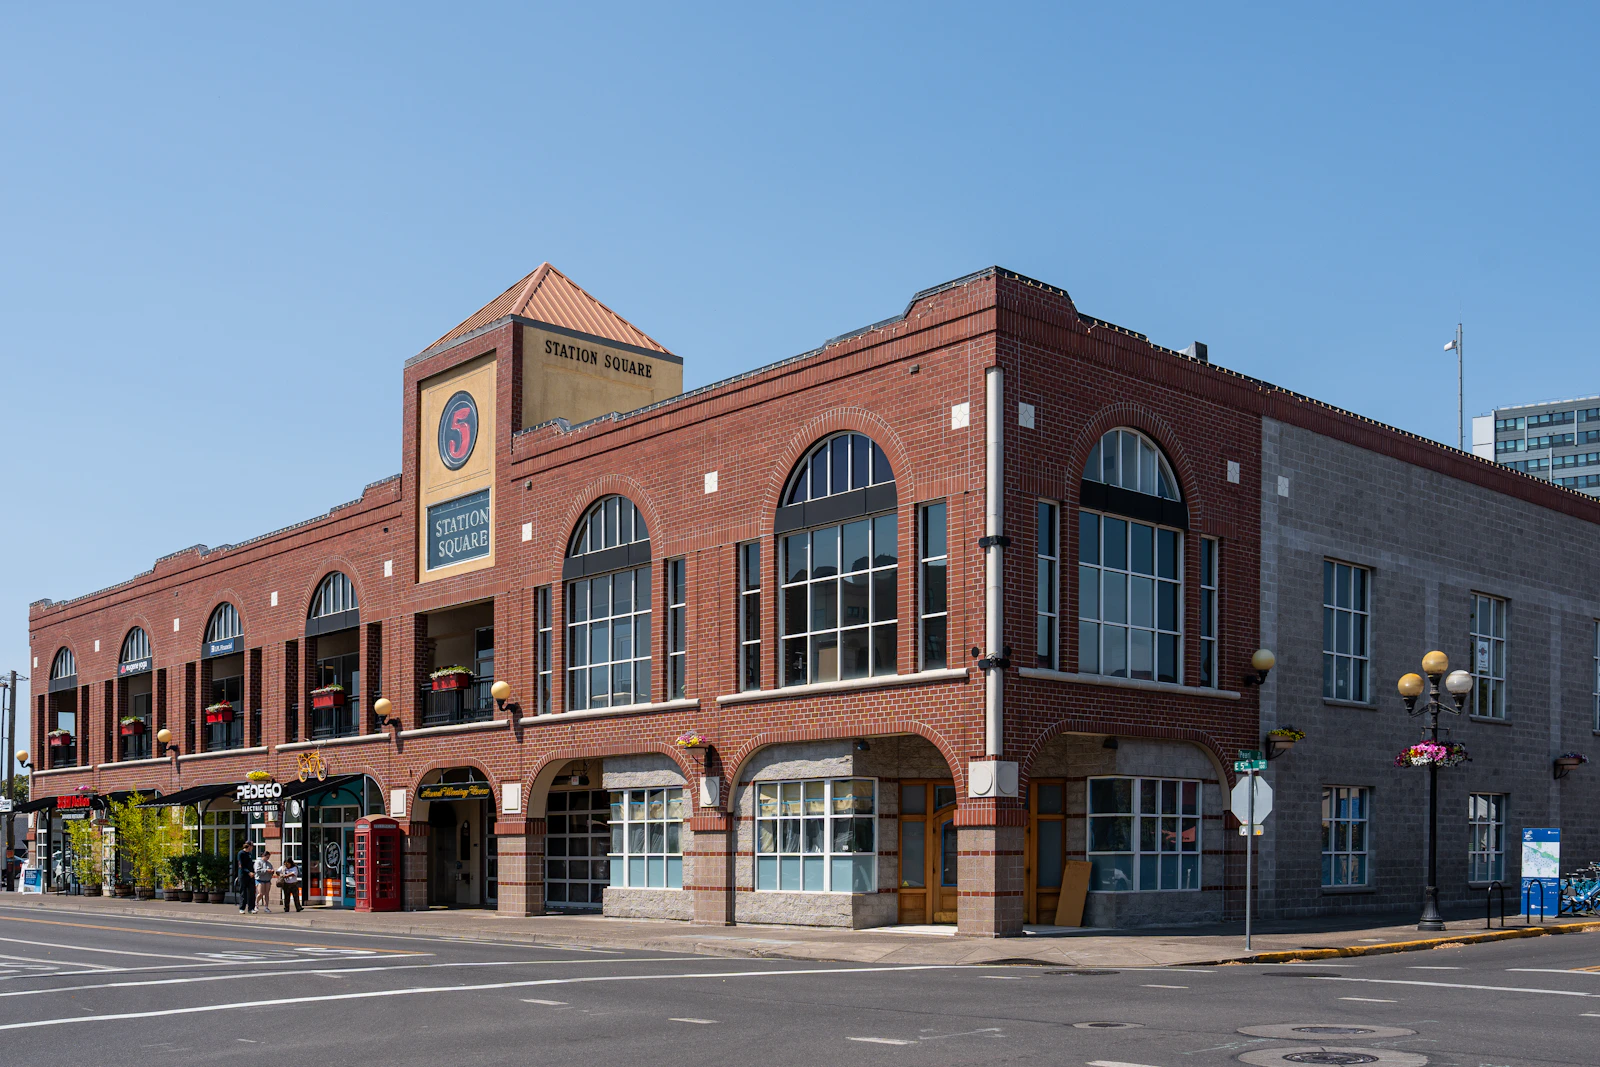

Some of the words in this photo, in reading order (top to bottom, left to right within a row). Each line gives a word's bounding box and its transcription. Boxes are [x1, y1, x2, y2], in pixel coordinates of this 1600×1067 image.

[545, 340, 598, 365] STATION
[604, 354, 652, 378] SQUARE
[449, 407, 471, 459] 5
[435, 506, 490, 538] STATION
[438, 529, 489, 558] SQUARE
[138, 660, 148, 671] yoga
[1234, 762, 1239, 771] E
[236, 783, 282, 800] PEDEGO
[241, 805, 264, 813] ELECTRIC
[264, 804, 279, 812] BIKES
